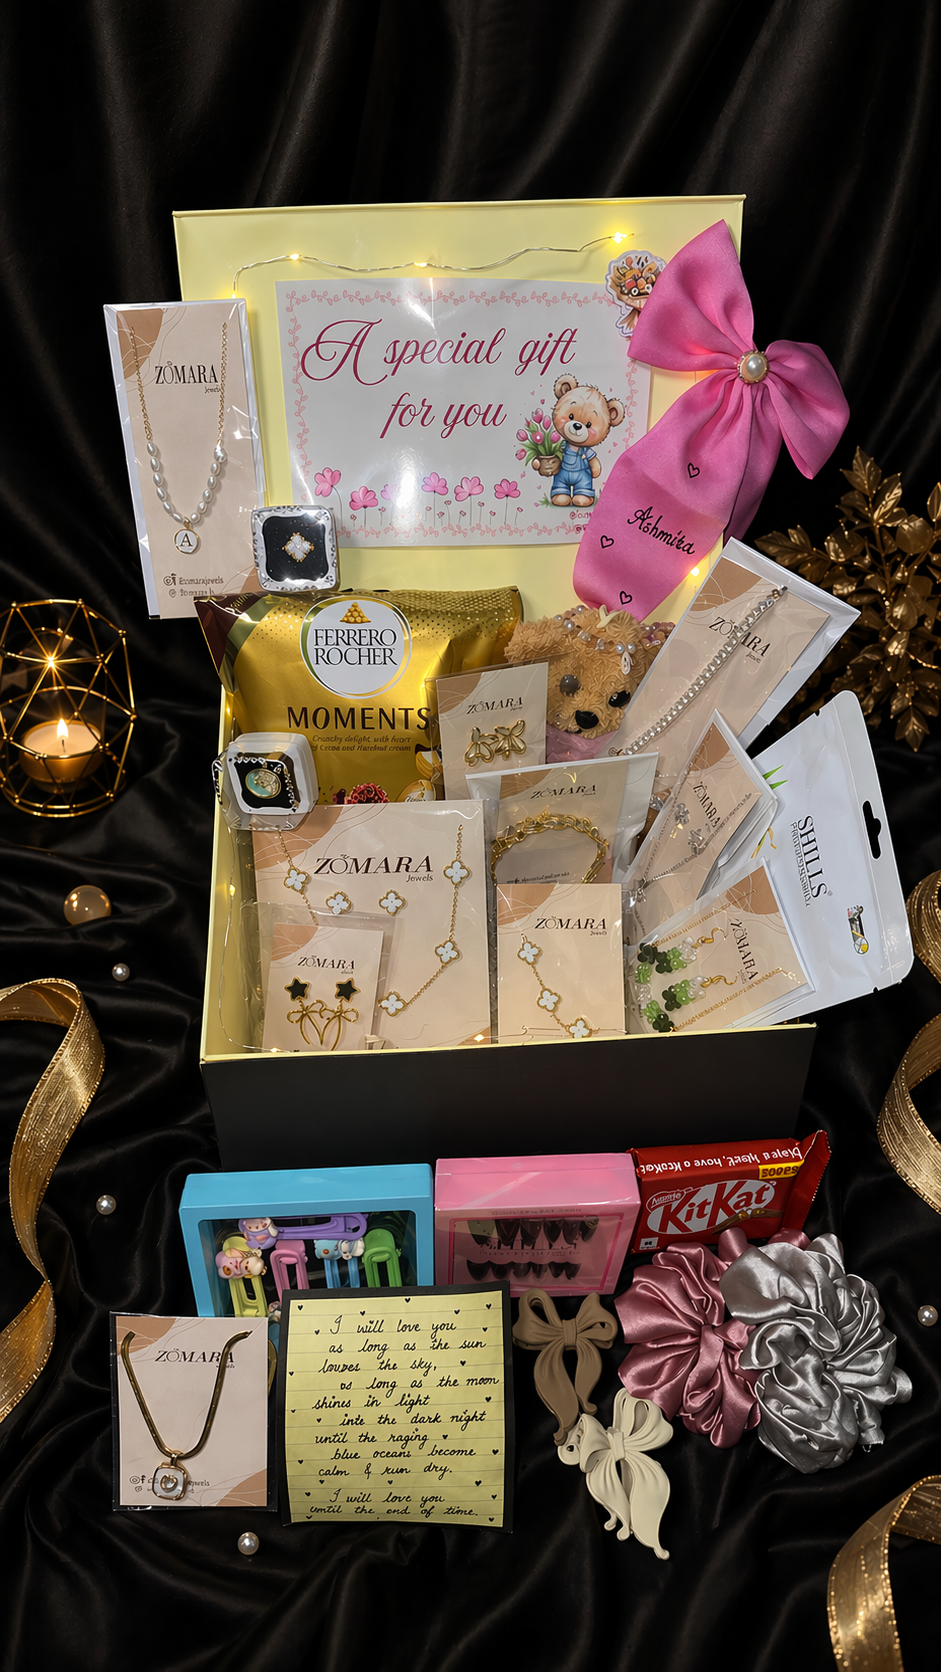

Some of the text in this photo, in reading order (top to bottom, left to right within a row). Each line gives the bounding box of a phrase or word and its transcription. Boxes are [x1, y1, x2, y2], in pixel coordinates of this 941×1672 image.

[300, 318, 578, 386] A special gift
[380, 392, 507, 439] for you
[313, 628, 397, 646] FERRERO
[313, 647, 398, 666] ROCHER
[287, 706, 431, 731] MOMENTS
[797, 815, 829, 899] SHILLS
[658, 1181, 772, 1235] KitKat
[356, 1319, 385, 1334] will
[396, 1319, 421, 1333] love
[430, 1322, 457, 1340] you
[357, 1338, 390, 1361] long
[403, 1342, 417, 1352] as
[458, 1339, 487, 1350] sun
[377, 1358, 398, 1371] the
[409, 1357, 437, 1378] sky,
[365, 1376, 398, 1399] long
[410, 1379, 423, 1389] as
[436, 1374, 460, 1388] the
[465, 1377, 500, 1386] moon
[394, 1392, 431, 1414] light
[376, 1413, 397, 1425] the
[410, 1412, 442, 1424] dark
[449, 1409, 487, 1432] night
[315, 1427, 430, 1451] until the raging
[330, 1447, 361, 1461] blue
[427, 1444, 477, 1457] become
[318, 1465, 350, 1477] calm
[423, 1461, 453, 1481] dry.
[346, 1491, 372, 1503] will
[382, 1491, 412, 1503] love
[419, 1495, 446, 1509] you
[354, 1505, 375, 1514] the
[420, 1505, 435, 1519] of
[443, 1505, 478, 1516] time.
